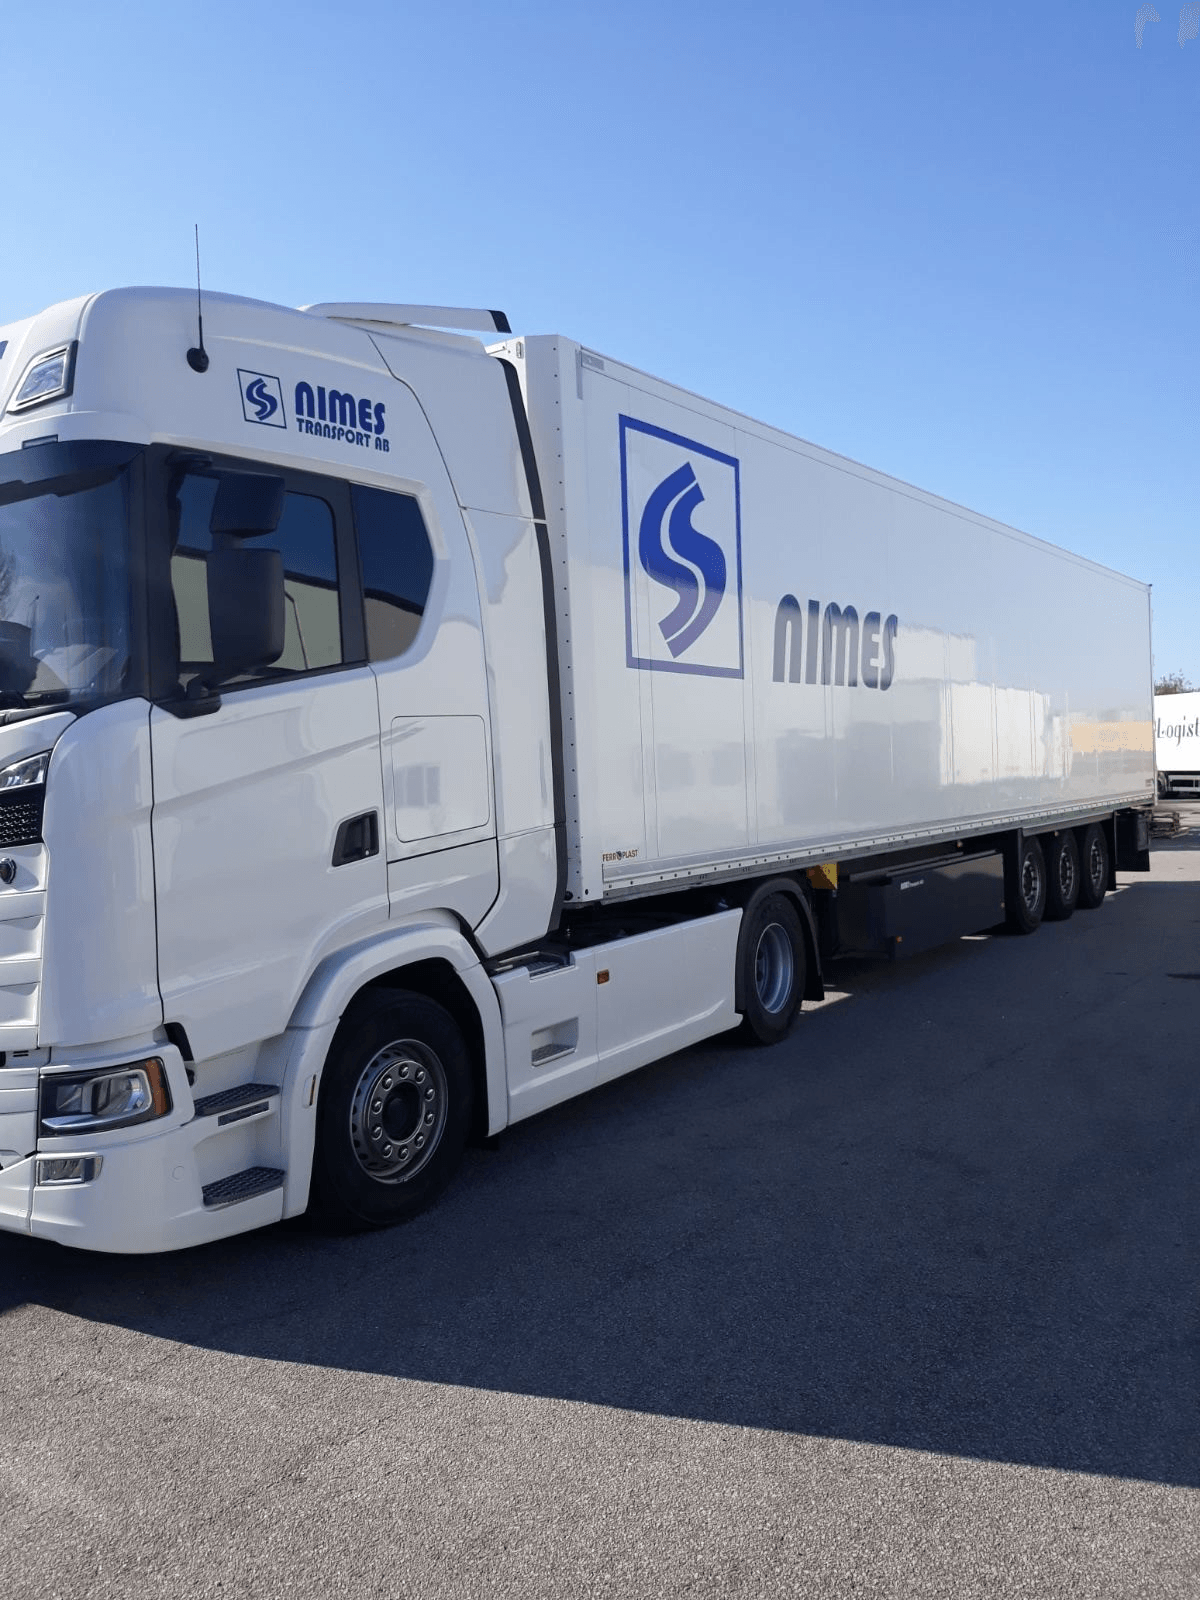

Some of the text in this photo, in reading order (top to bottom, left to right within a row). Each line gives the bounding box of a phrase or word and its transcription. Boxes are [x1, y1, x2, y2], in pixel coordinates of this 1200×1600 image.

[295, 381, 386, 435] NIMES
[296, 418, 390, 453] TRANSPORT AB
[772, 593, 898, 691] NIMES
